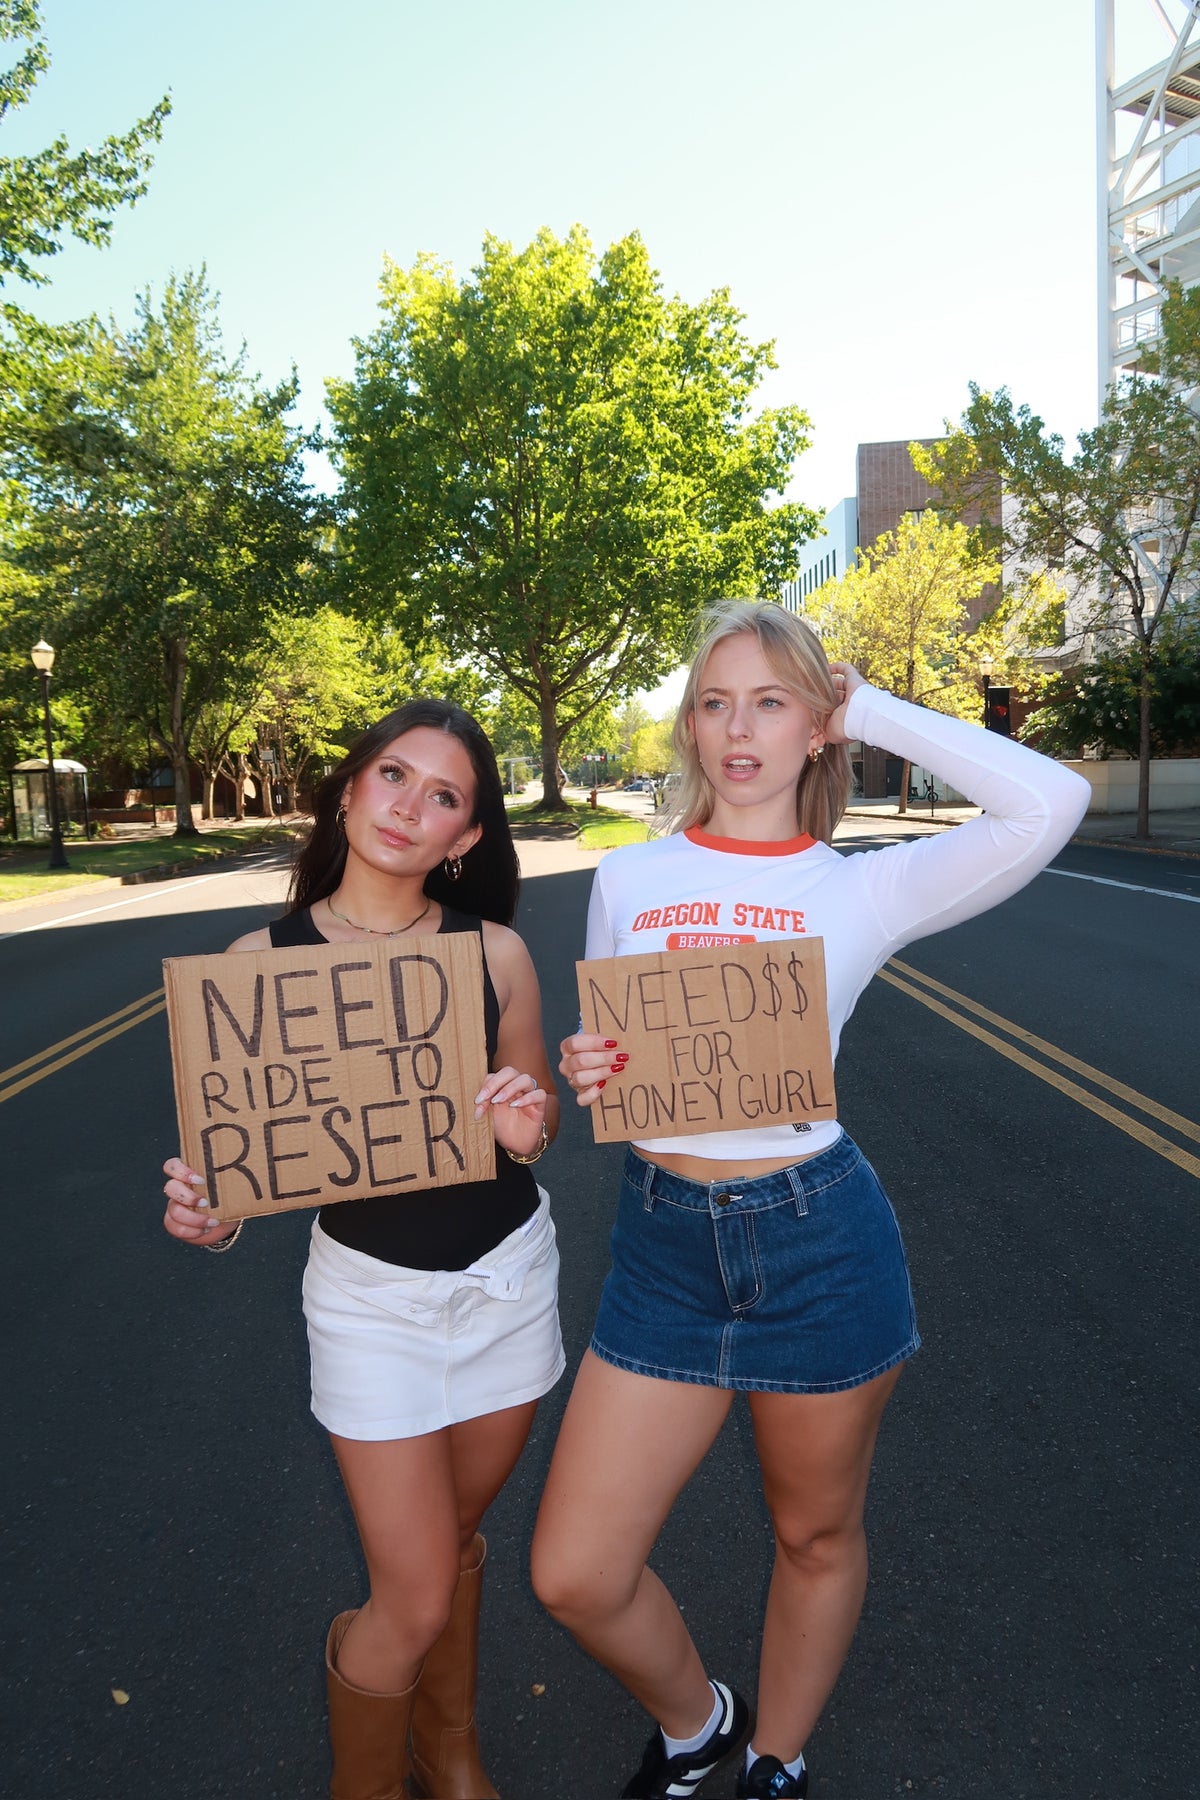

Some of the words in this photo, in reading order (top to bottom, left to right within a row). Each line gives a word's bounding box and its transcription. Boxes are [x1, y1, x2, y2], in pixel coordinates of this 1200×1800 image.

[631, 902, 721, 932] OREGON
[732, 902, 806, 933] STATE
[201, 954, 449, 1062] NEED
[200, 1057, 339, 1119] RIDE
[376, 1042, 443, 1096] TO
[670, 1030, 740, 1077] FOR
[600, 1077, 724, 1132] HONEY
[737, 1069, 833, 1120] GURL
[200, 1094, 466, 1210] RESER
